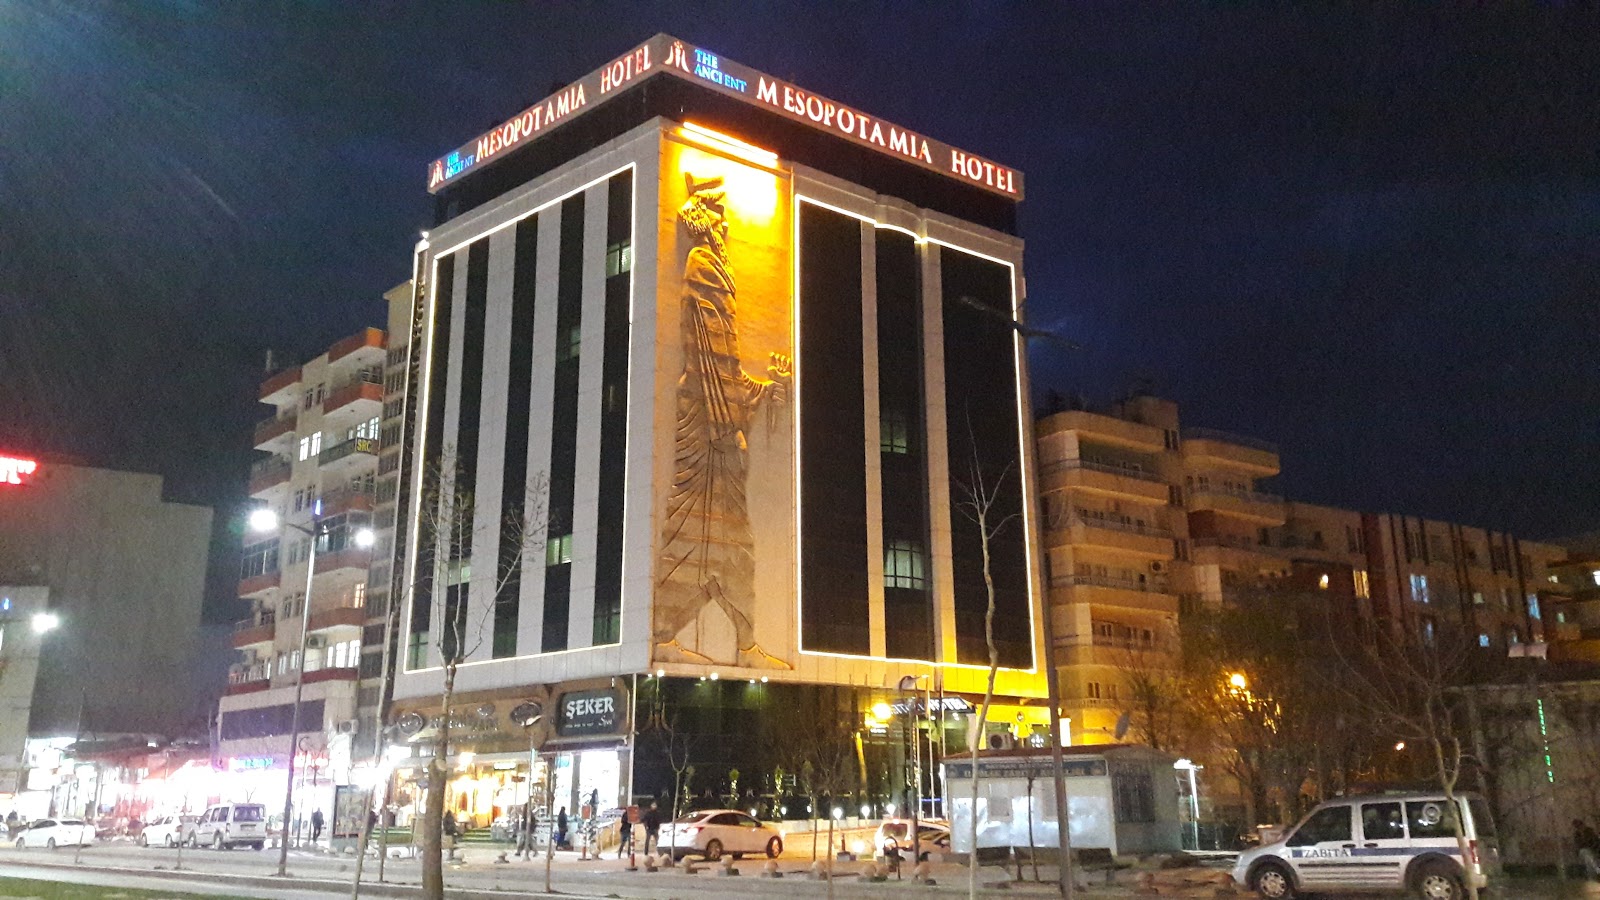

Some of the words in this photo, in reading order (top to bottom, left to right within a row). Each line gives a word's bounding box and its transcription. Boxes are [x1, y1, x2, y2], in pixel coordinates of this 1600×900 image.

[694, 48, 718, 70] THE
[694, 63, 747, 93] ANCIENT
[476, 83, 586, 163] MESOPOTAMIA
[600, 44, 651, 94] HOTEL
[756, 76, 933, 164] MESOPOTAMIA
[951, 150, 1018, 194] HOTEL
[566, 696, 614, 720] ŞEKER
